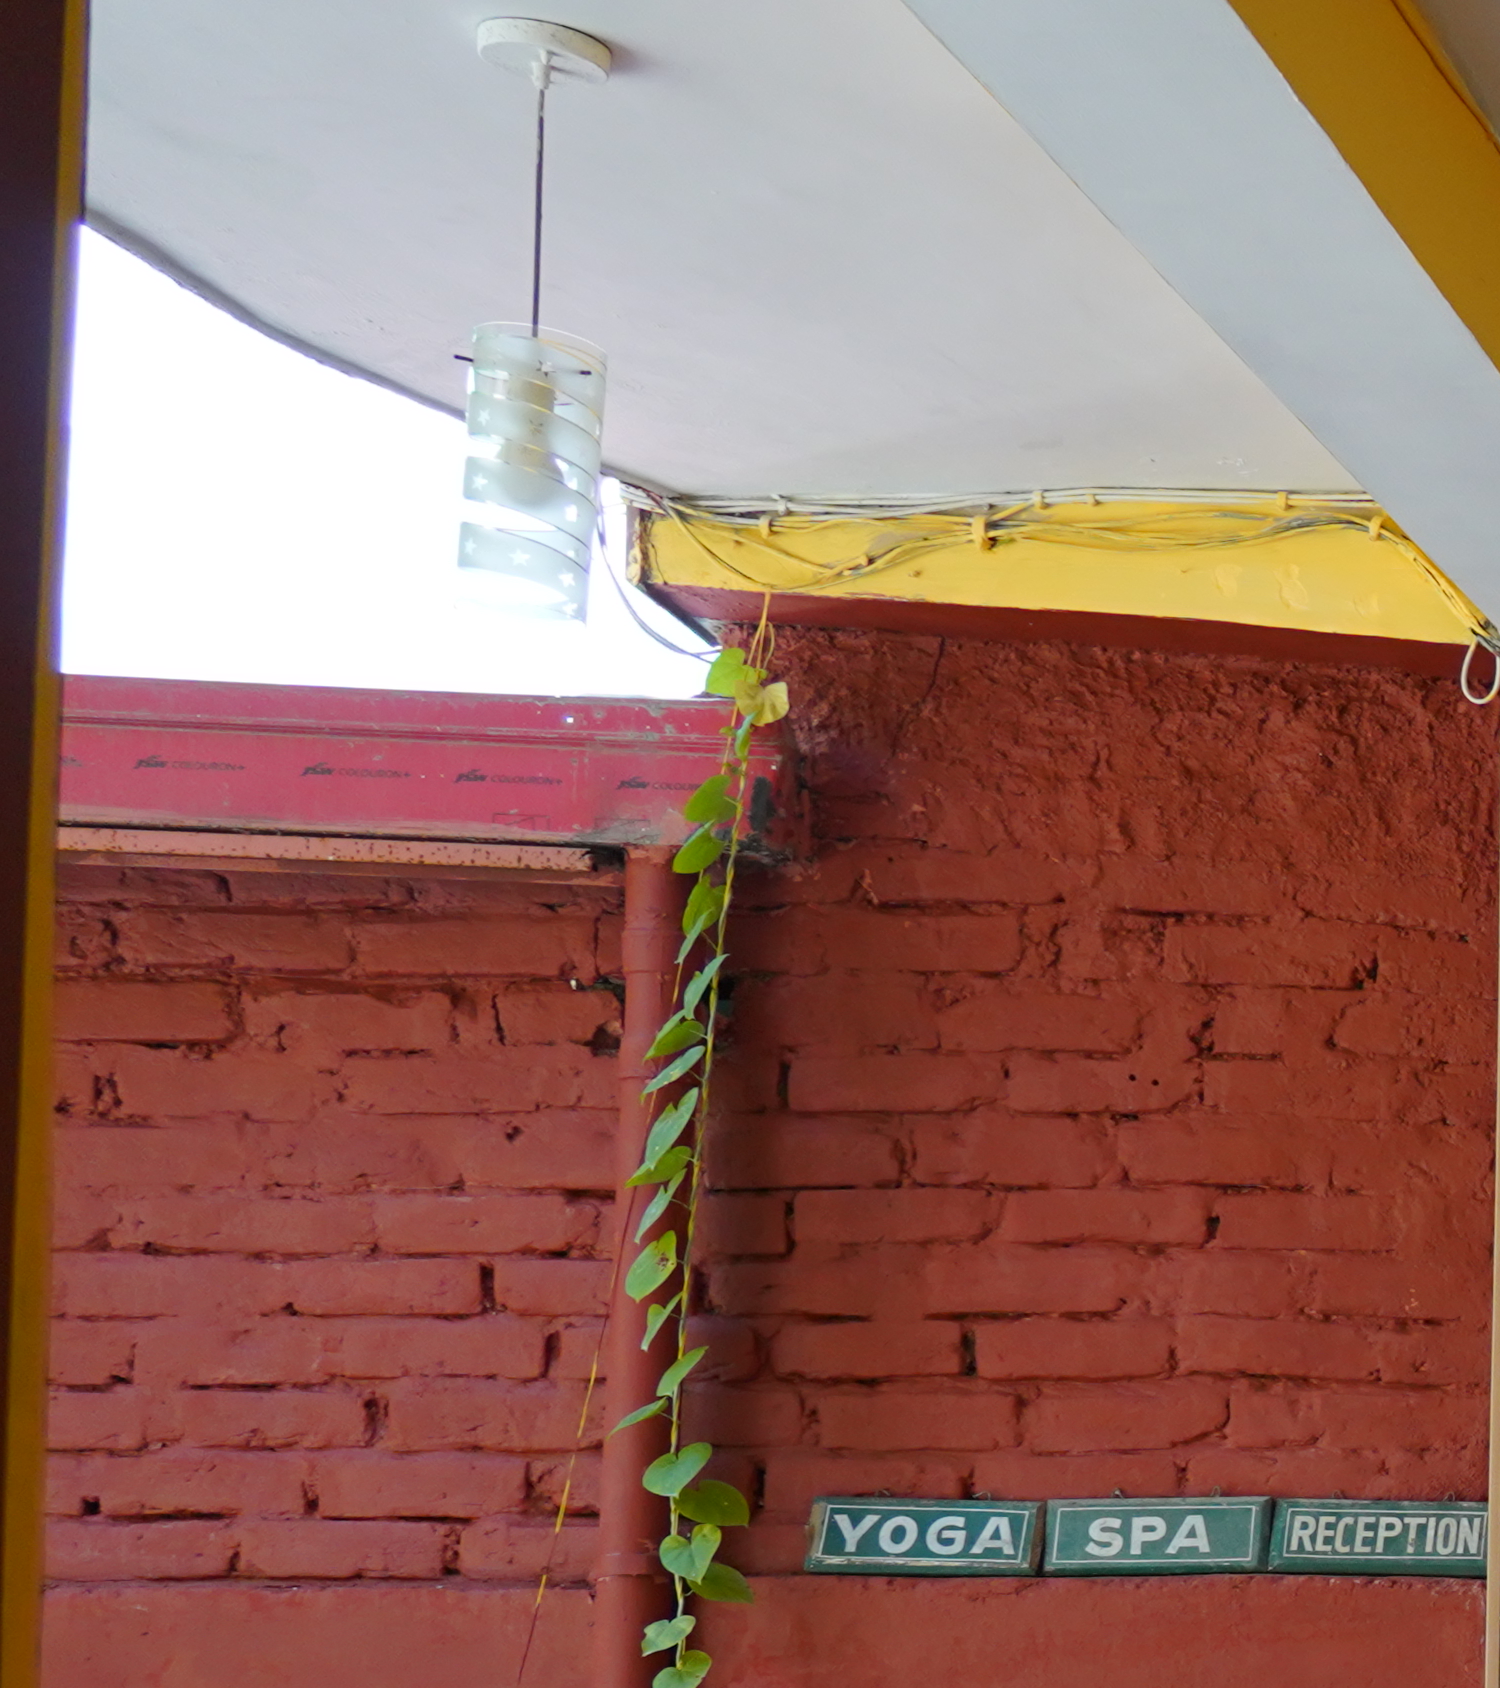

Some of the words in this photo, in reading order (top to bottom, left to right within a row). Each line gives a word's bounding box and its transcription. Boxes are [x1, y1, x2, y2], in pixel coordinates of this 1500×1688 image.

[833, 1513, 1016, 1556] YOGA
[1085, 1514, 1212, 1557] SPA
[1289, 1514, 1482, 1556] RECEPTION
